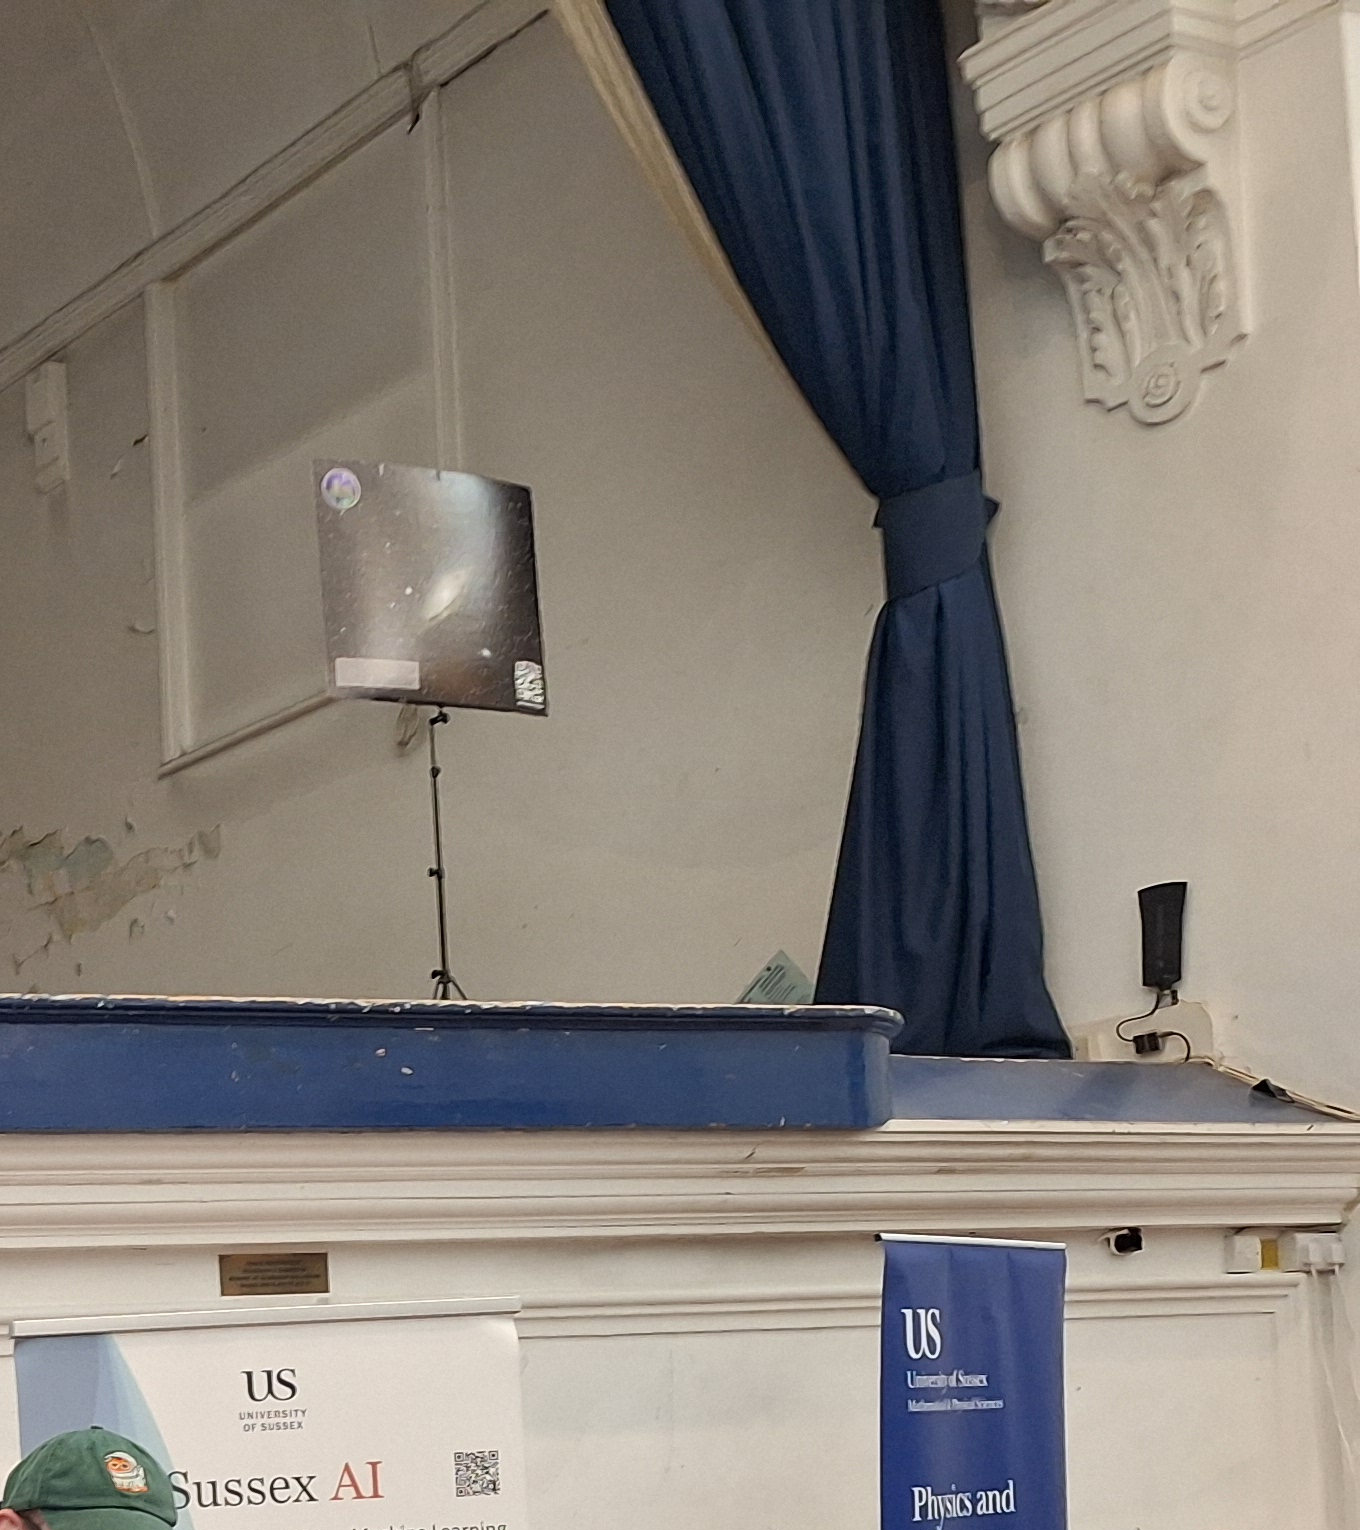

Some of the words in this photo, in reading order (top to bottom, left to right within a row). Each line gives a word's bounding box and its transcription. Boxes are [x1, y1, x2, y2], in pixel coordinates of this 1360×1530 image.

[238, 1408, 308, 1421] UNIVERSITY
[243, 1422, 257, 1433] OF
[260, 1420, 304, 1432] SUSSEX
[166, 1469, 319, 1510] Sussex
[329, 1459, 386, 1502] AI
[976, 1479, 1017, 1516] and
